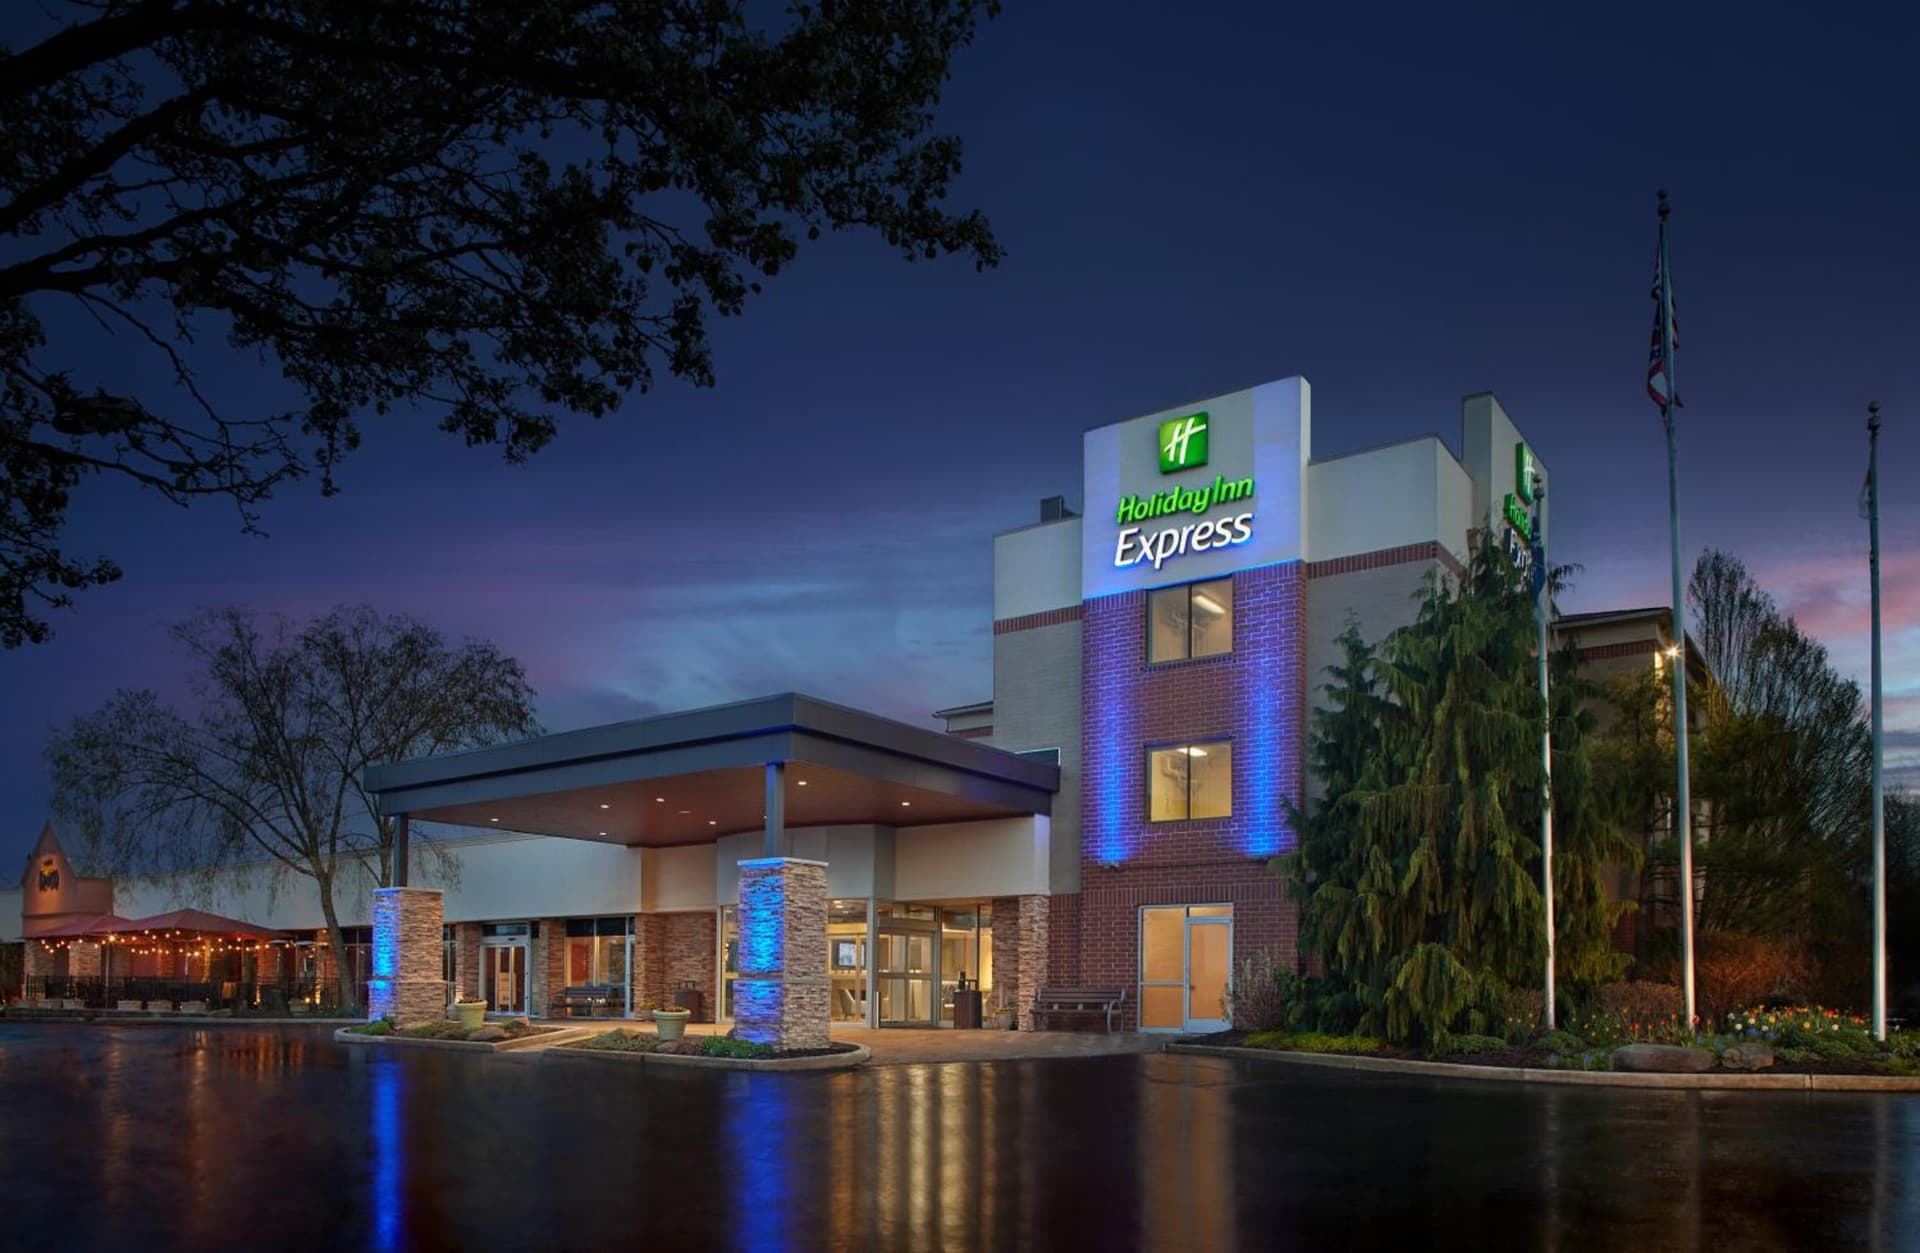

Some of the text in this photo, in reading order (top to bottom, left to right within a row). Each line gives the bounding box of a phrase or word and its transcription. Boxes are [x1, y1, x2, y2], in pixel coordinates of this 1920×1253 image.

[1164, 417, 1207, 465] H
[1117, 474, 1254, 524] Holiday Inn
[1114, 512, 1253, 569] Express
